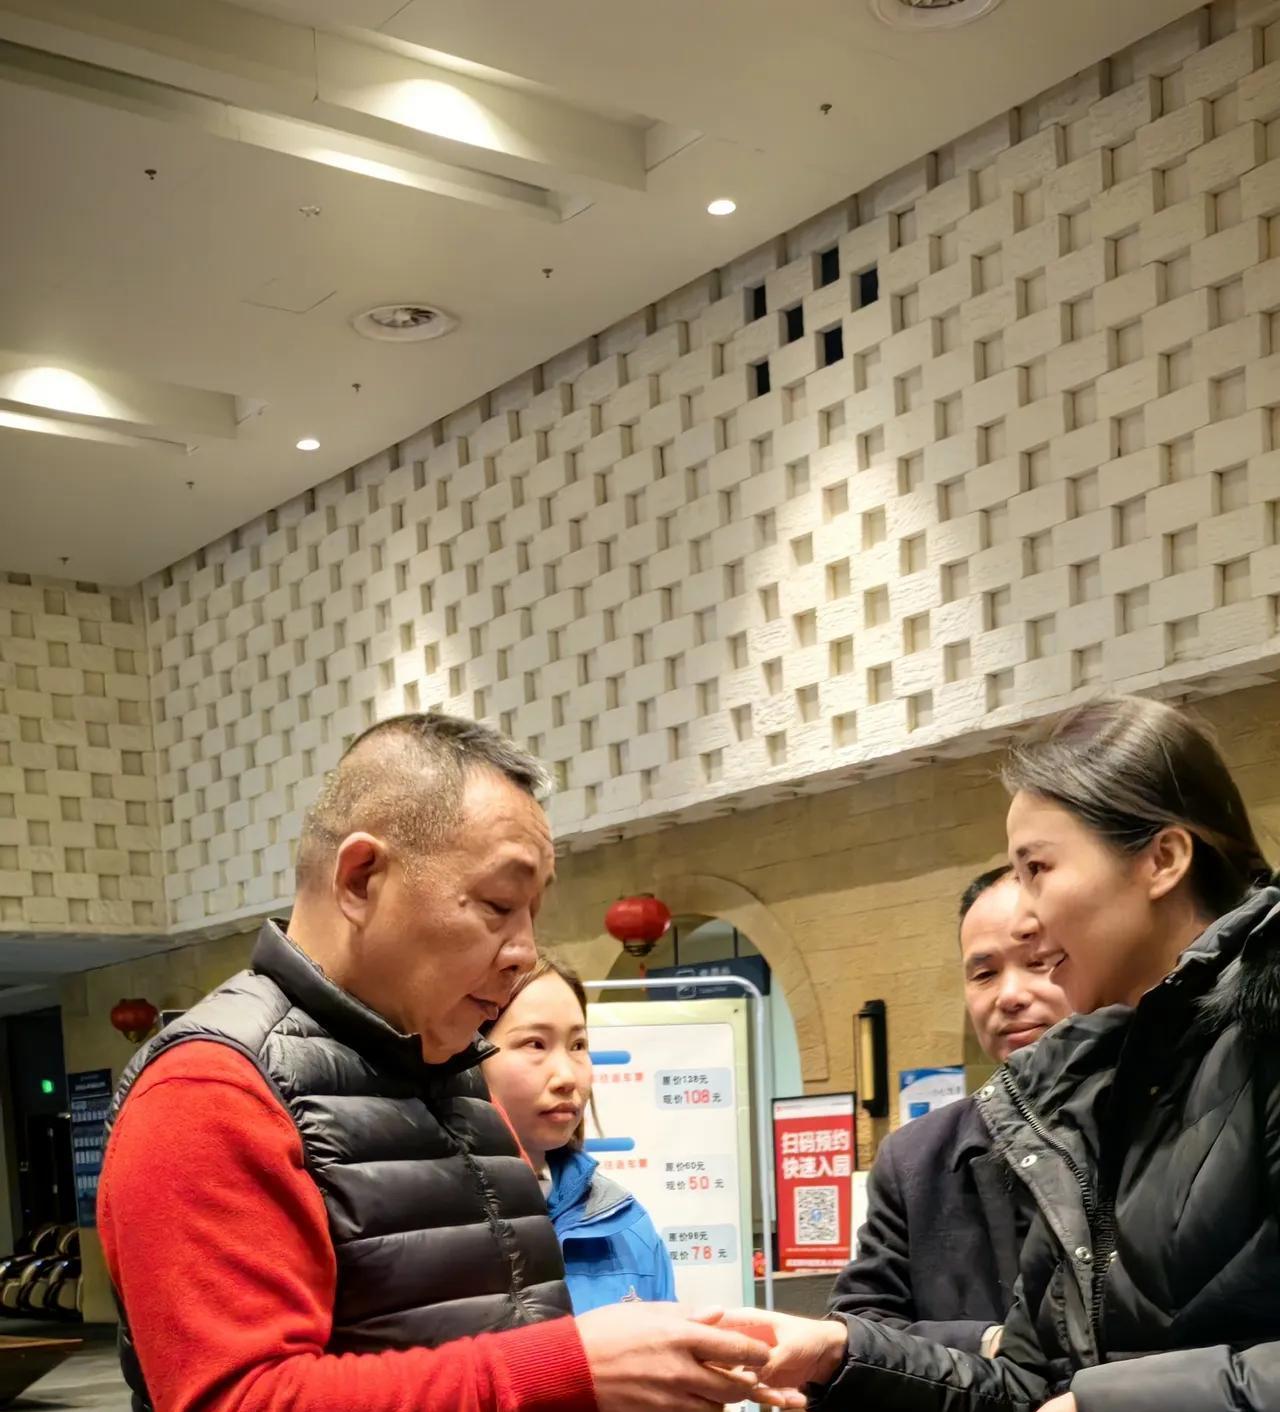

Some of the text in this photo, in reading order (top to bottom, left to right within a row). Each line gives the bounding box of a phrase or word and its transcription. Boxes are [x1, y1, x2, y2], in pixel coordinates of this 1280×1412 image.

[782, 1128, 850, 1155] 扫码预约
[782, 1154, 851, 1180] 快速入园
[665, 1175, 725, 1191] 现价50元
